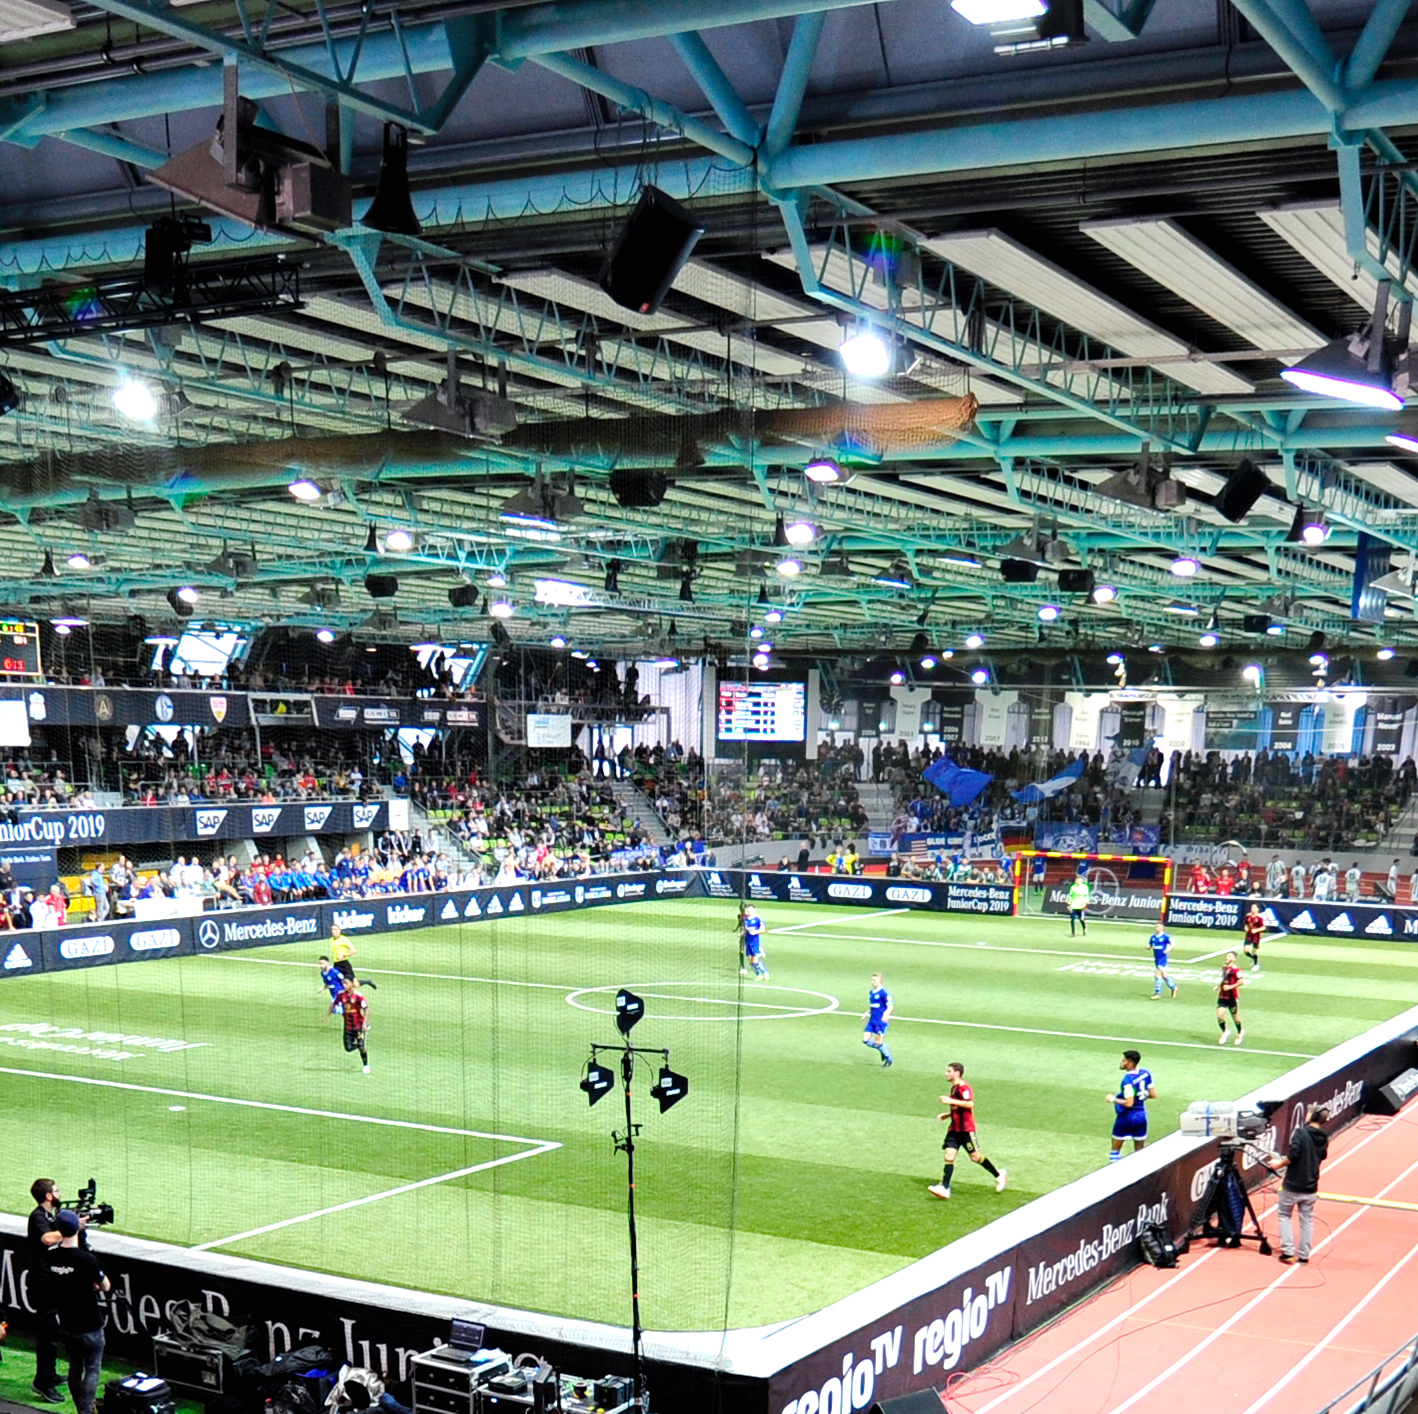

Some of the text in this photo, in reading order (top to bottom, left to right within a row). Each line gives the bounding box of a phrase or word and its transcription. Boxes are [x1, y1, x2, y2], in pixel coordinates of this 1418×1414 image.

[198, 815, 220, 829] SAP
[254, 813, 275, 827] SAP
[306, 811, 326, 825] SAP
[355, 809, 374, 823] SAP
[68, 815, 106, 839] 2019
[833, 885, 868, 897] GAZI
[891, 889, 928, 901] GAZI
[948, 885, 1010, 900] Mercedes-Benz
[947, 898, 1009, 913] JuniorCup 2019
[1170, 897, 1238, 914] Mercedes-Benz
[387, 904, 426, 925] kicker
[1168, 911, 1238, 928] JuniorCup 2019
[224, 917, 317, 942] Mercedes-Benz
[137, 933, 176, 948] GAZI
[67, 941, 109, 957] GAZI
[1026, 1216, 1136, 1306] Mercedes-Benz
[913, 1265, 1011, 1376] regioTV
